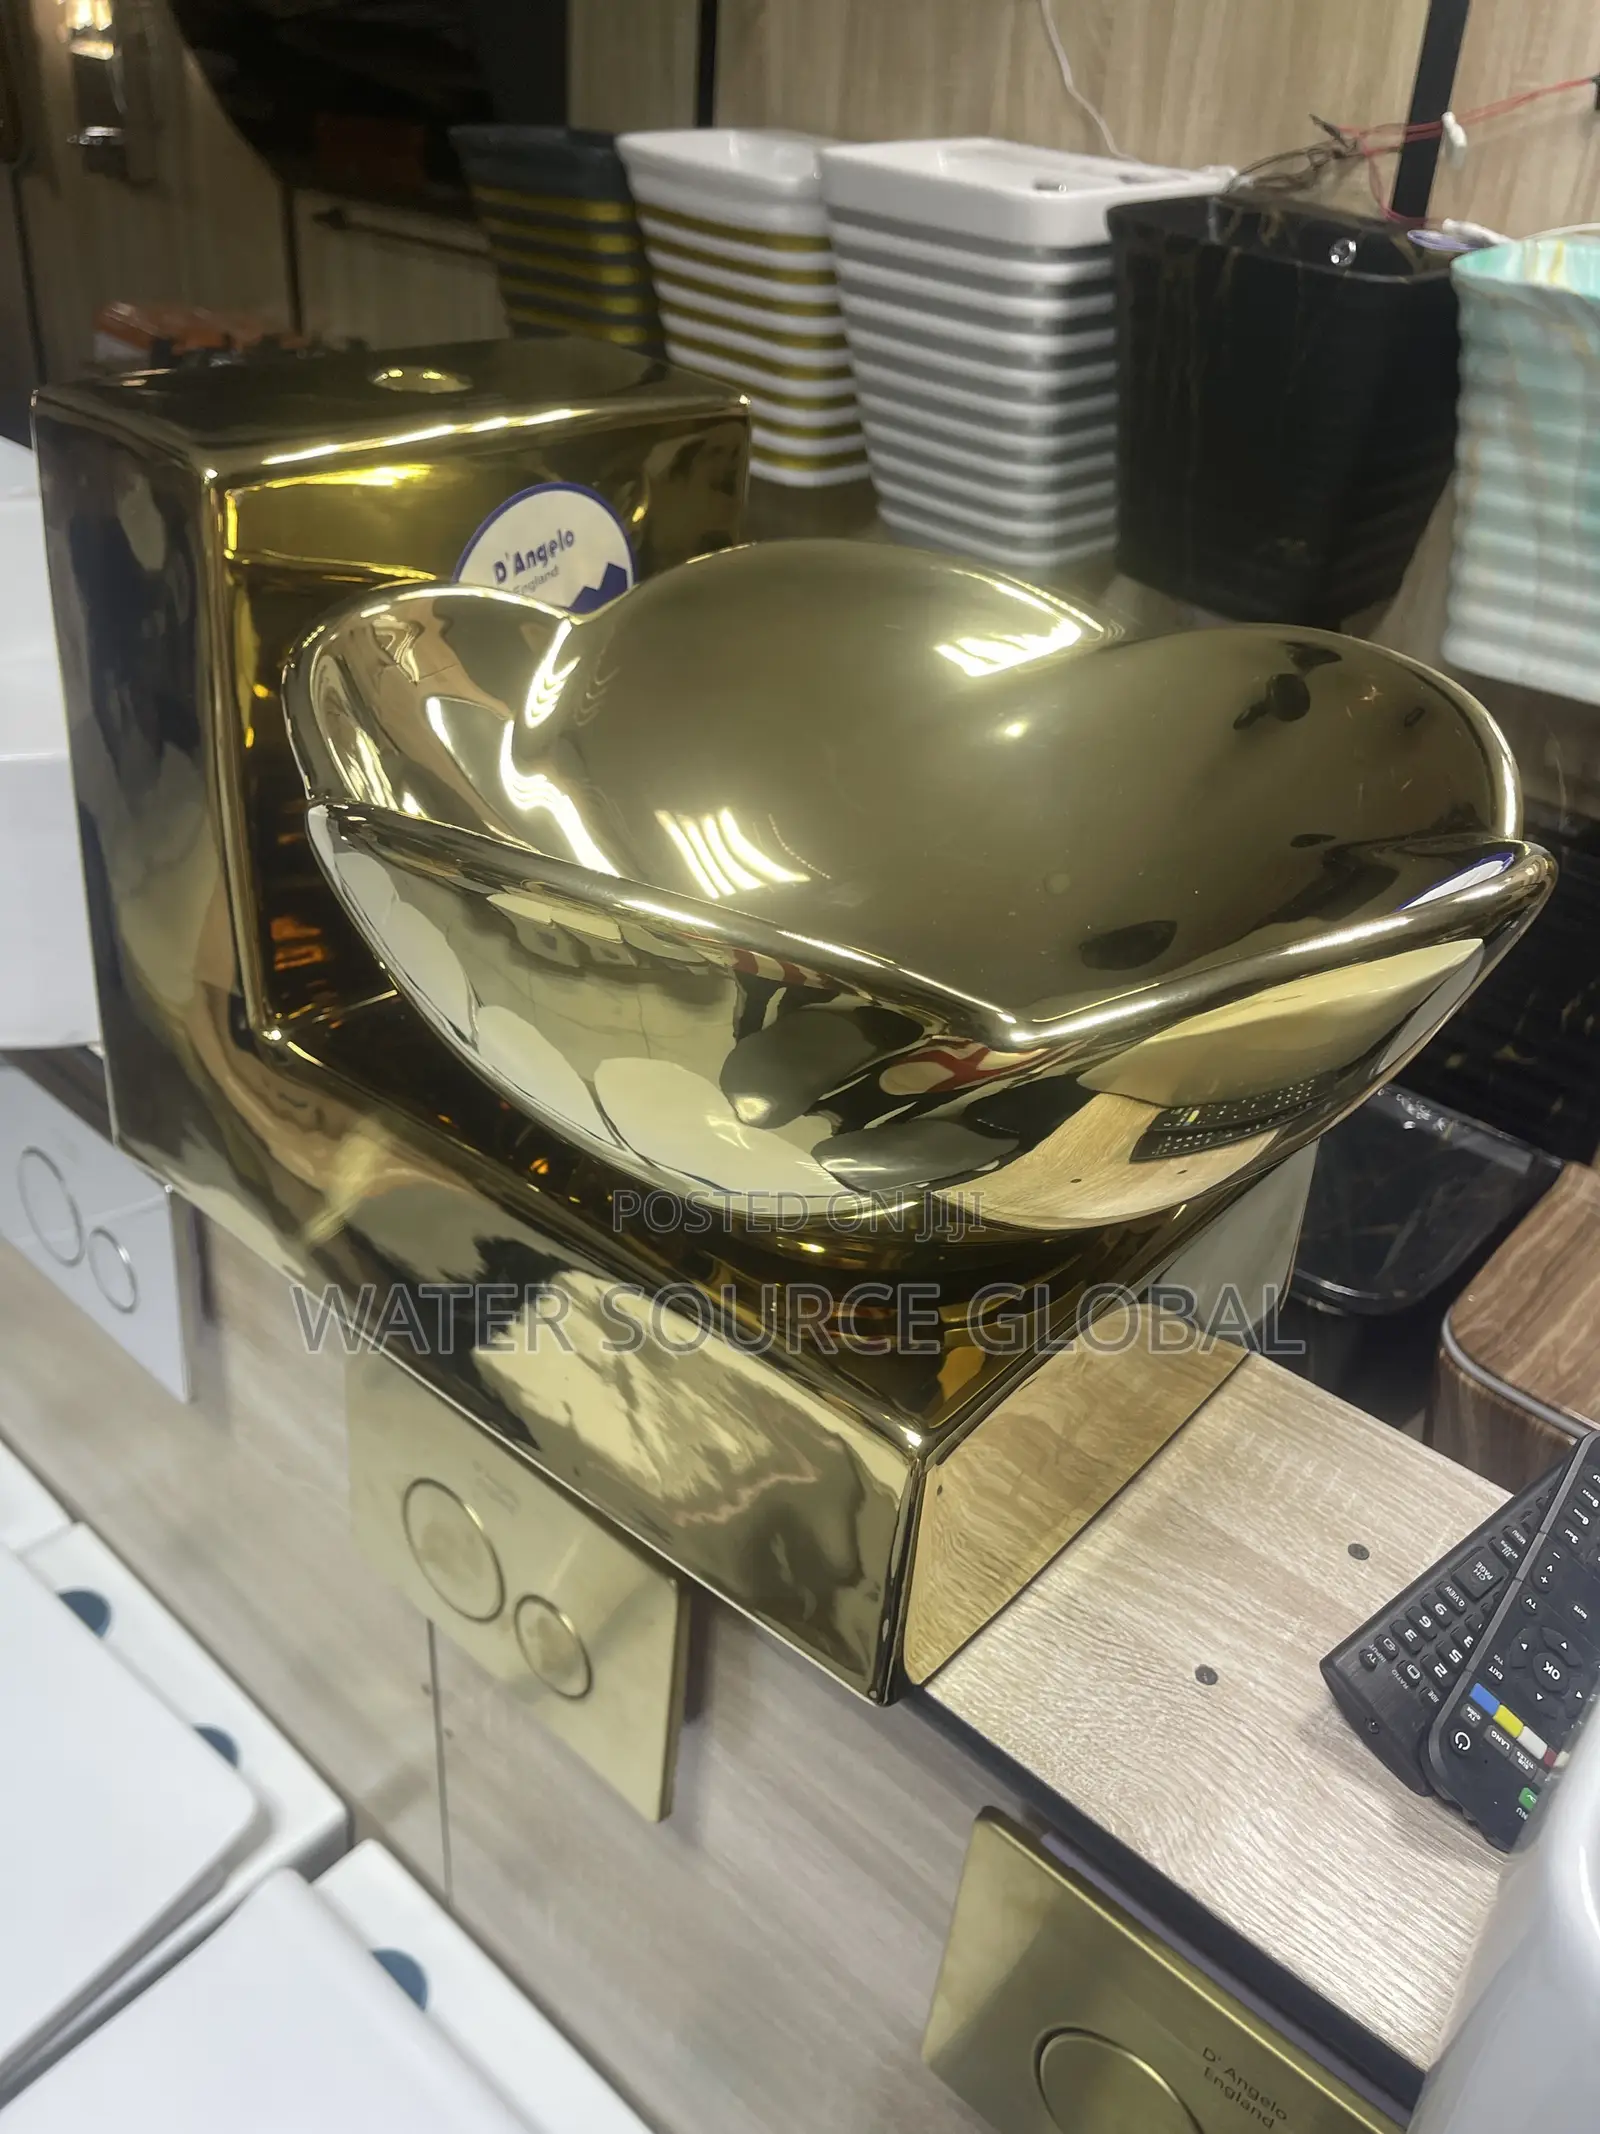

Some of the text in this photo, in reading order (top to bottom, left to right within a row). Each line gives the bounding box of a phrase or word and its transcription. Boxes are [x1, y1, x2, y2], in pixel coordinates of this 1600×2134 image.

[493, 529, 575, 585] D'Angelo
[1475, 1561, 1494, 1580] PAGE
[1434, 1603, 1448, 1616] 9
[1526, 1598, 1536, 1609] TV
[1419, 1616, 1432, 1628] 6
[1404, 1629, 1417, 1642] 3
[1366, 1653, 1377, 1664] TV
[1368, 1643, 1387, 1664] INPUT
[1448, 1649, 1463, 1663] 5
[1433, 1663, 1448, 1678] 2
[1488, 1665, 1503, 1680] EXIT
[1543, 1661, 1560, 1680] OK
[1391, 1669, 1409, 1690] RATIO
[1491, 1730, 1510, 1750] LANG
[1203, 2066, 1275, 2131] England
